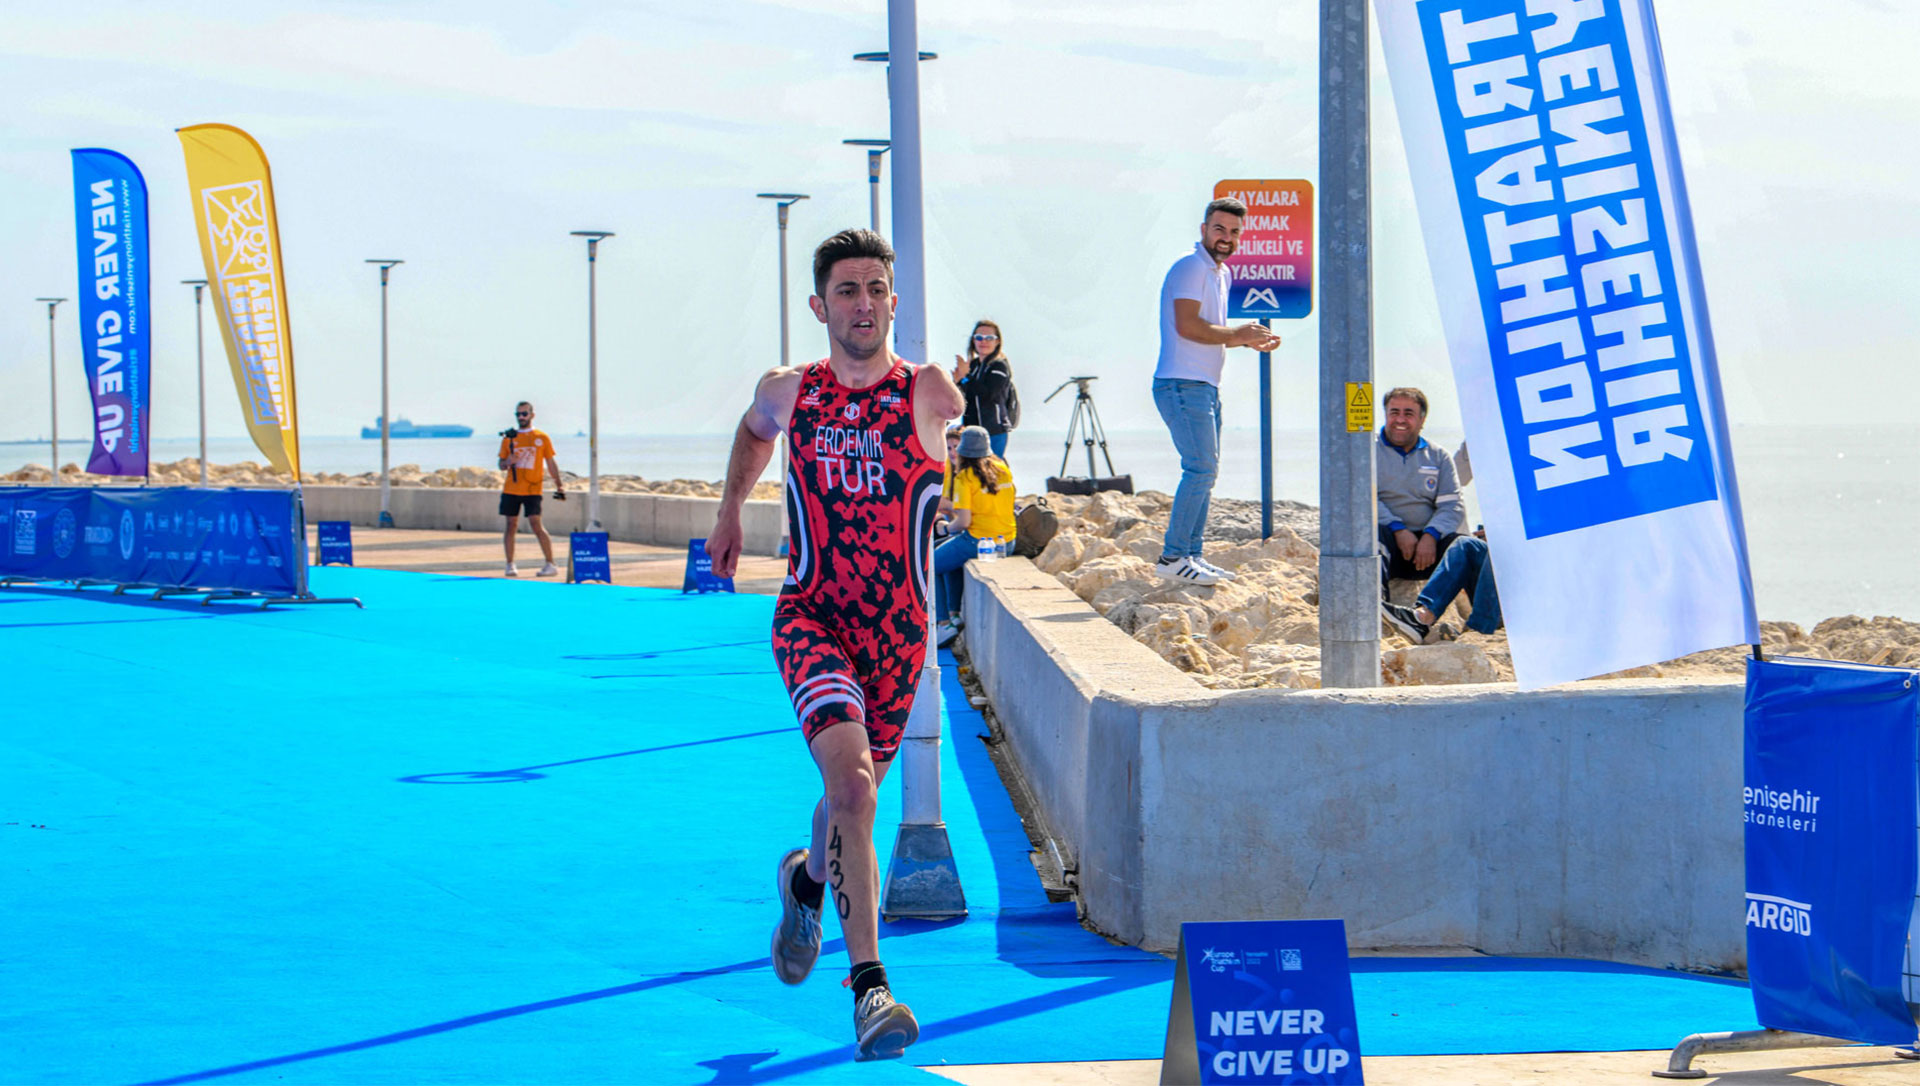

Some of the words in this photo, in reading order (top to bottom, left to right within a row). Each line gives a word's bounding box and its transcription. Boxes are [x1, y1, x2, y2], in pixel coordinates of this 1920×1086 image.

[1240, 215, 1290, 235] IKMAK
[1286, 240, 1304, 256] VE
[1231, 264, 1296, 280] YASAKTIR
[815, 426, 884, 459] ERDEMIR
[816, 456, 887, 496] TUR
[829, 825, 851, 920] 430
[1210, 965, 1226, 973] Cup
[1209, 1009, 1325, 1037] NEVER
[1212, 1050, 1294, 1077] GIVE
[1303, 1049, 1350, 1075] UP
